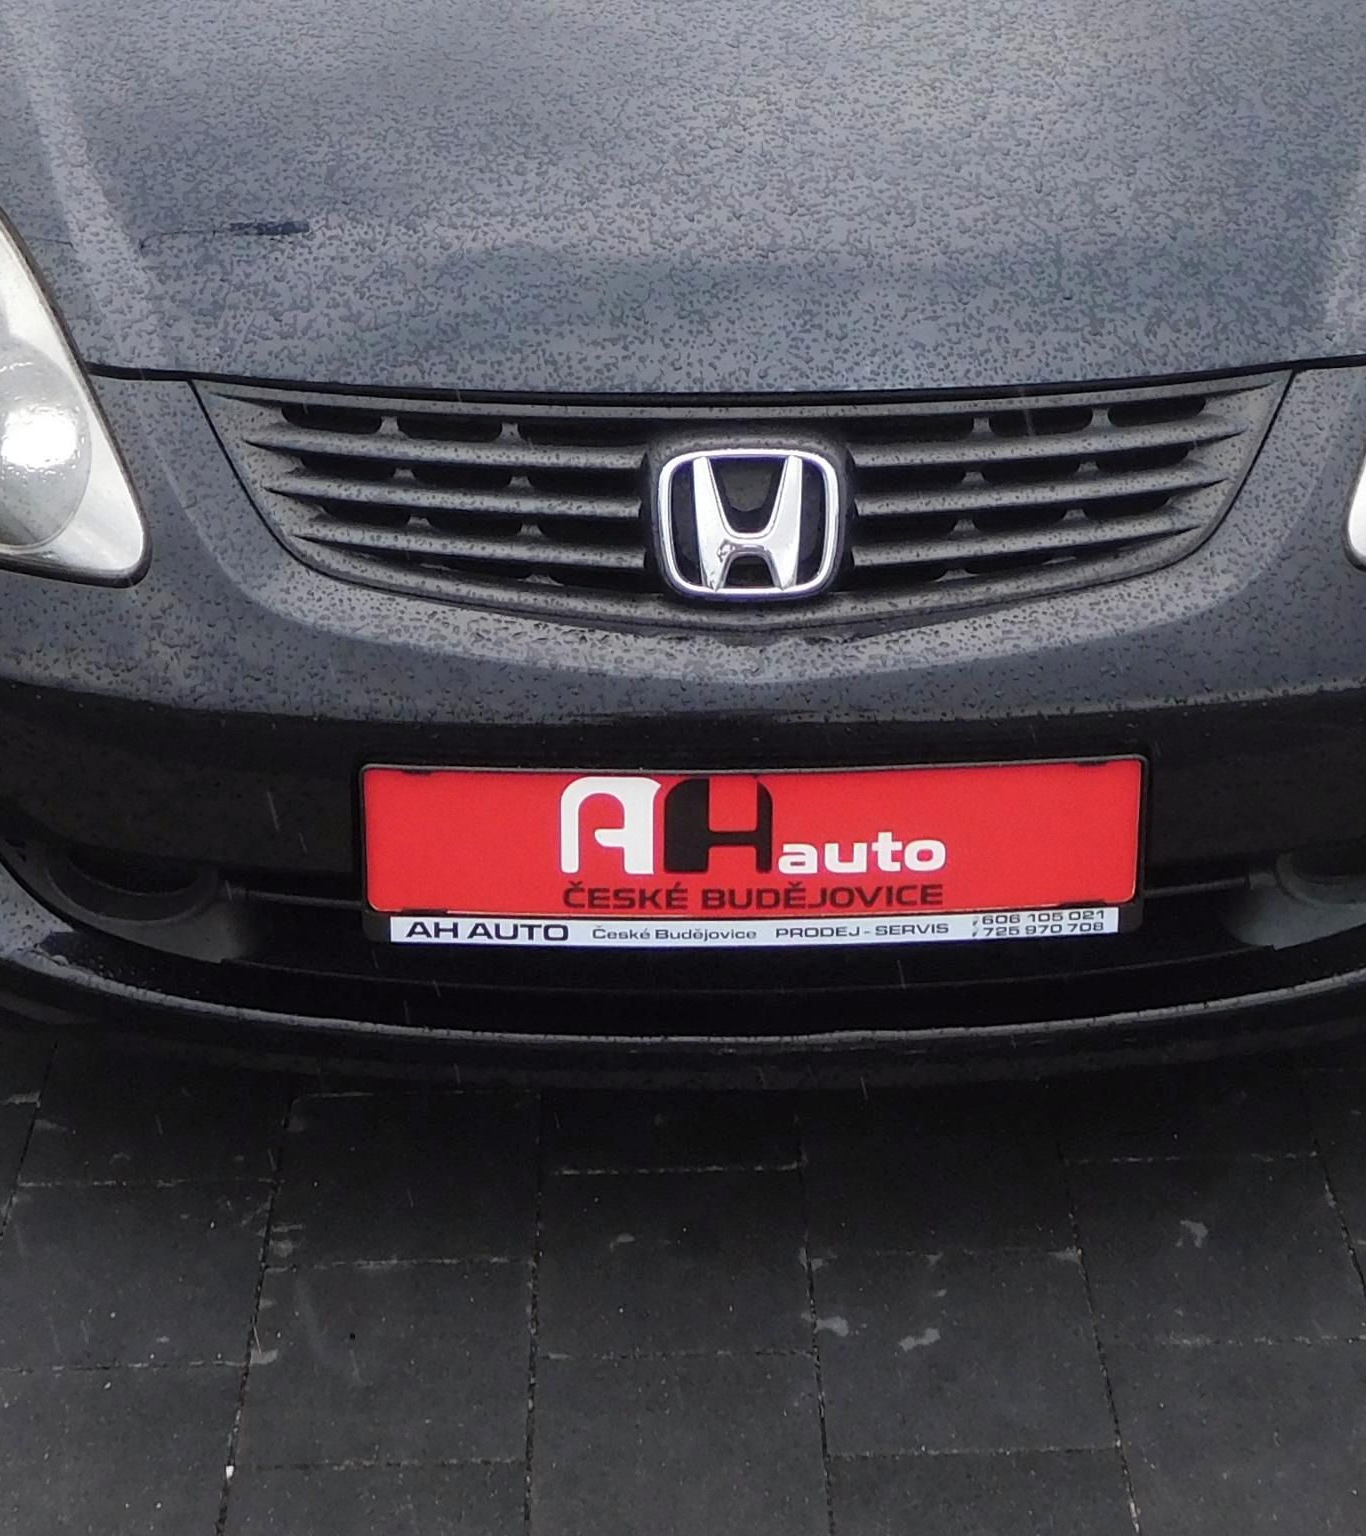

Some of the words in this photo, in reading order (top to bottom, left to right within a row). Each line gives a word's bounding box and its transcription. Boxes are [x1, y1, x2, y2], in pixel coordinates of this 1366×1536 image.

[777, 831, 947, 875] auto
[562, 881, 689, 910] ČESKÉ
[701, 881, 943, 910] BUDĚJOVICE
[1029, 912, 1063, 923] 105
[1068, 909, 1105, 921] 021
[405, 921, 460, 939] AH
[467, 922, 570, 942] AUTO
[592, 925, 651, 940] České
[655, 927, 757, 941] Budějovice
[775, 926, 861, 939] PRODEJ
[875, 923, 950, 937] SERVIS
[983, 926, 1020, 937] 725
[1025, 924, 1063, 936] 970
[1068, 920, 1103, 932] 708
